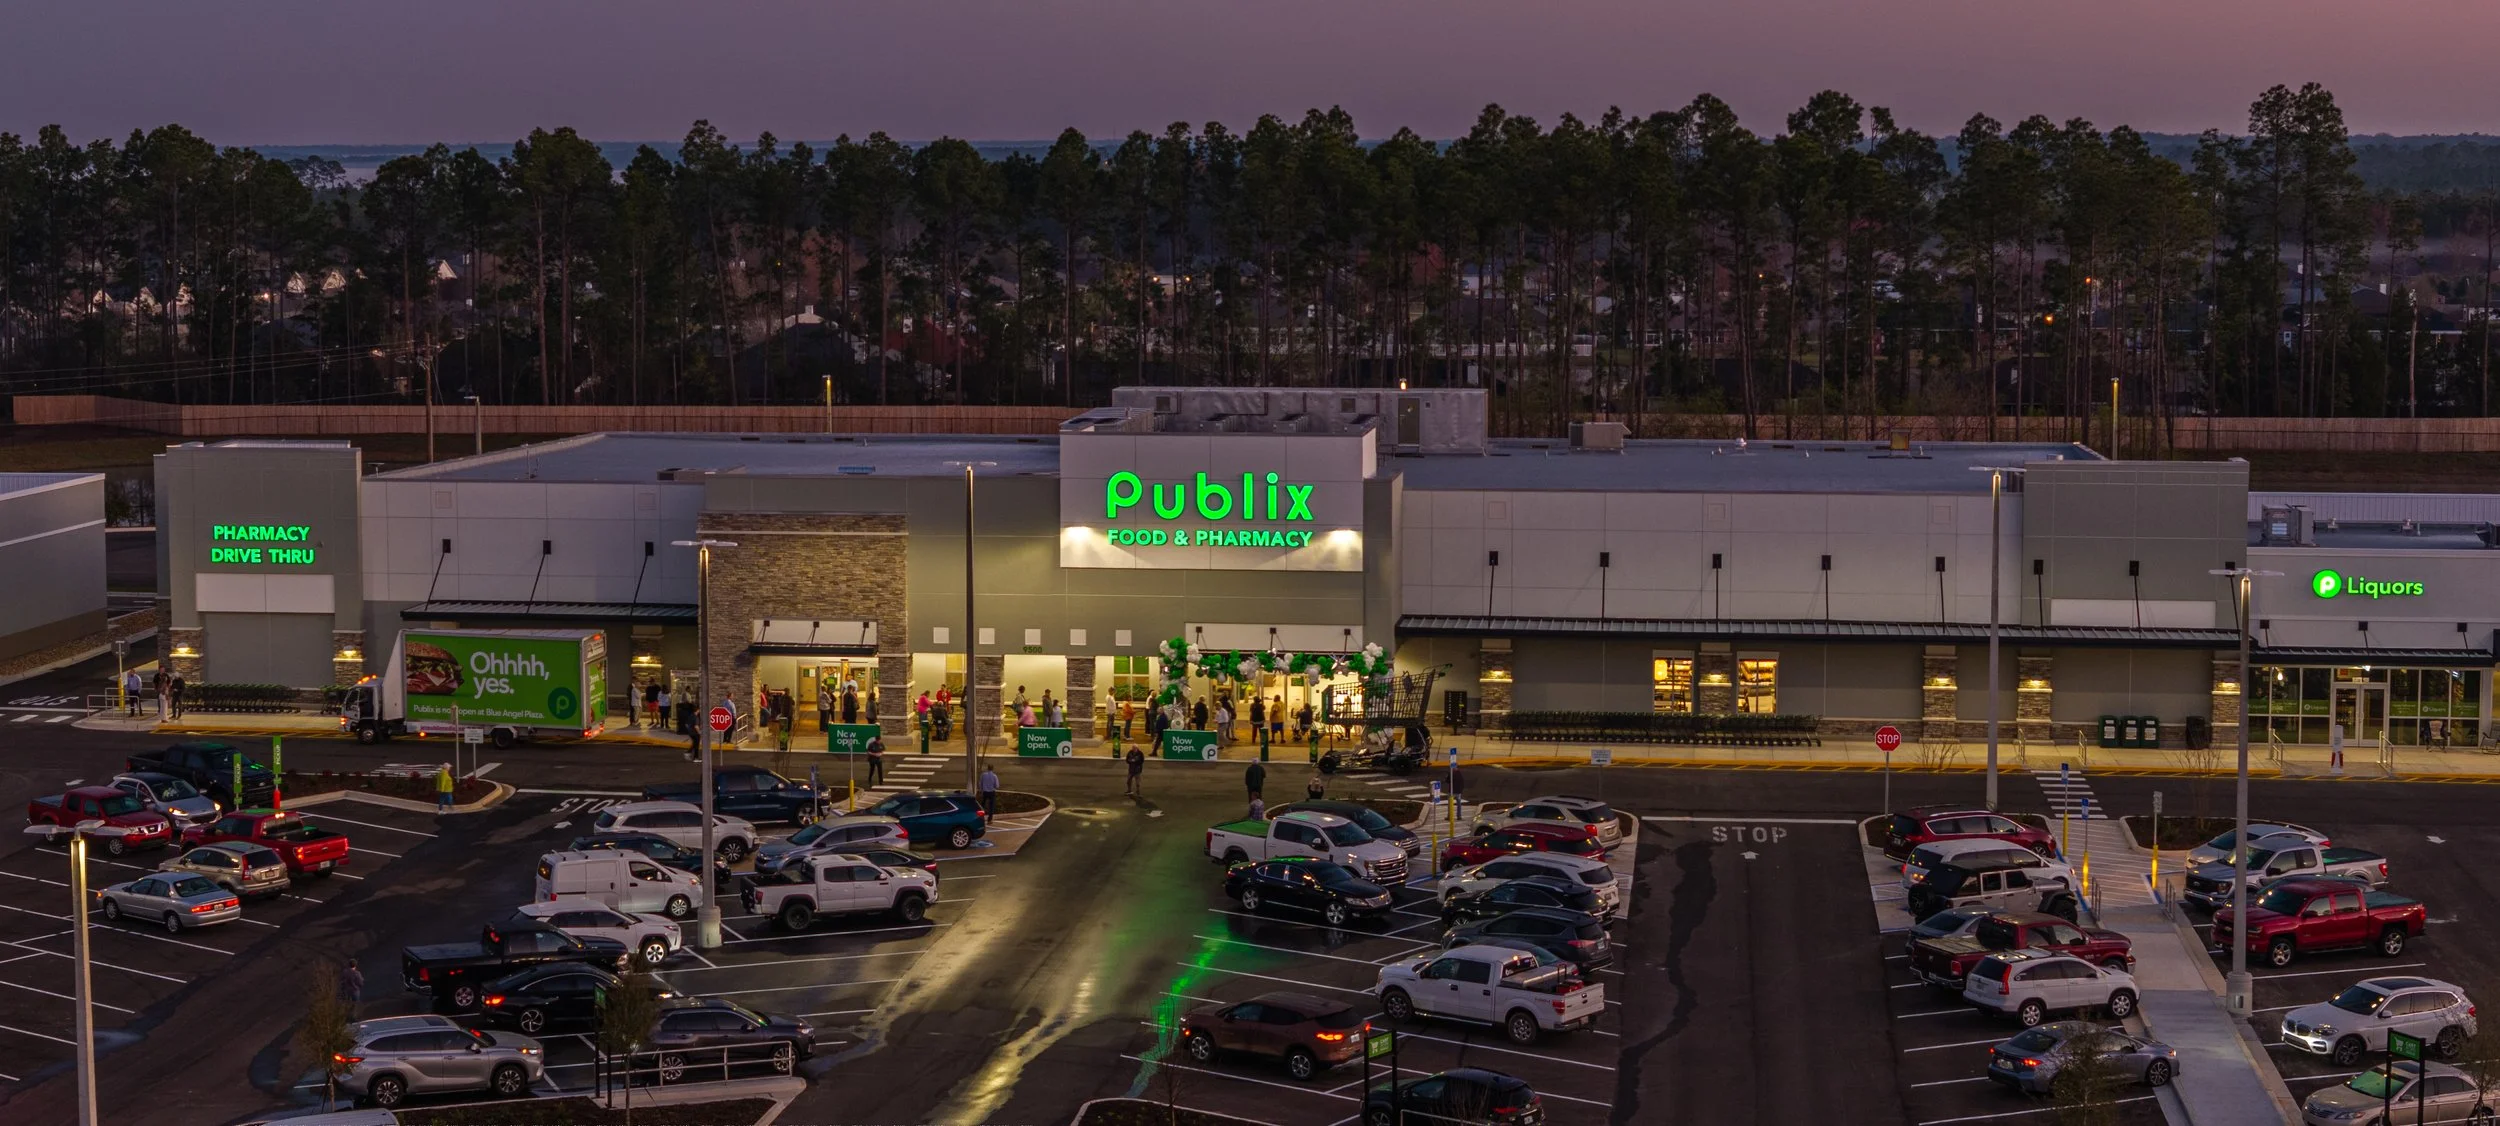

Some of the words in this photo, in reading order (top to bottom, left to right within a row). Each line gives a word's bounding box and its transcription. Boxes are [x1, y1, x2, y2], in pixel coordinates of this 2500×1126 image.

[1106, 471, 1314, 520] Publix
[213, 525, 310, 541] PHARMACY
[1107, 529, 1167, 546] FOOD
[1173, 530, 1188, 546] &
[1196, 530, 1313, 547] PHARMACY
[211, 548, 262, 563] DRIVE
[268, 549, 315, 564] THRU
[2347, 576, 2424, 599] Liquors
[1022, 646, 1043, 654] 9500
[470, 651, 550, 681] Ohhhh,
[473, 677, 515, 699] yes.
[413, 704, 434, 713] Publix
[435, 705, 441, 713] is
[458, 708, 477, 717] open
[477, 708, 485, 716] at
[486, 708, 501, 716] Blue
[502, 709, 524, 719] Angel
[524, 709, 545, 719] Plaza.
[710, 714, 731, 724] STOP
[1027, 734, 1046, 742] Now
[1027, 741, 1051, 750] open.
[1172, 736, 1192, 744] Now
[1877, 734, 1899, 744] STOP
[1172, 743, 1196, 752] open.
[1711, 826, 1787, 844] STOP
